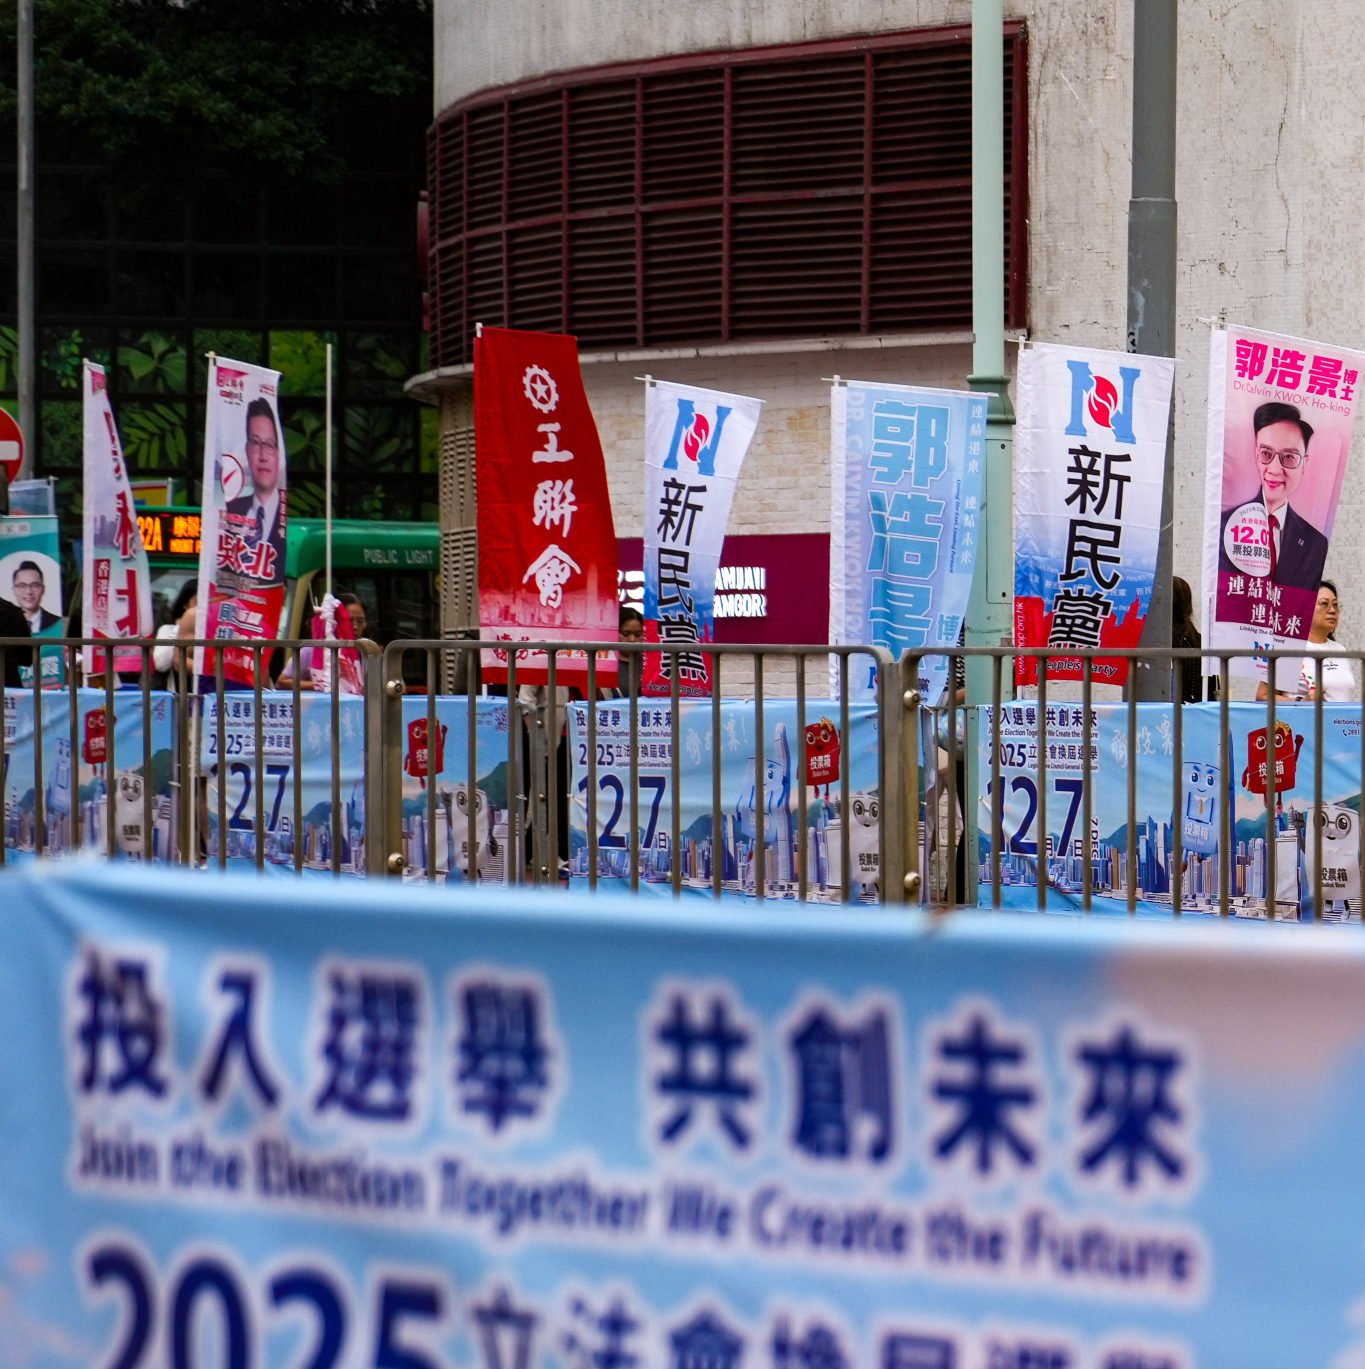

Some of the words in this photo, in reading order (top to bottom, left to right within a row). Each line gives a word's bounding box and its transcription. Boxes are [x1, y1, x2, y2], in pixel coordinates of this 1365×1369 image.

[1235, 339, 1343, 399] 郭浩景
[1340, 368, 1358, 401] 博士
[1274, 390, 1309, 406] KWOK
[1311, 400, 1350, 416] Ho-king
[522, 422, 581, 609] 工聯會
[363, 549, 398, 563] PUBLIC
[406, 550, 433, 564] LIGHT
[579, 743, 614, 766] 225
[1259, 761, 1284, 777] 投箱
[76, 945, 554, 1133] 投入選舉
[655, 993, 1184, 1186] 共創未來
[78, 1130, 158, 1180] Join
[170, 1138, 240, 1192] the
[255, 1140, 425, 1208] Election
[438, 1156, 647, 1234] Together
[665, 1186, 733, 1238] We
[750, 1186, 907, 1254] Create
[924, 1207, 1005, 1266] the
[1024, 1207, 1192, 1284] Future
